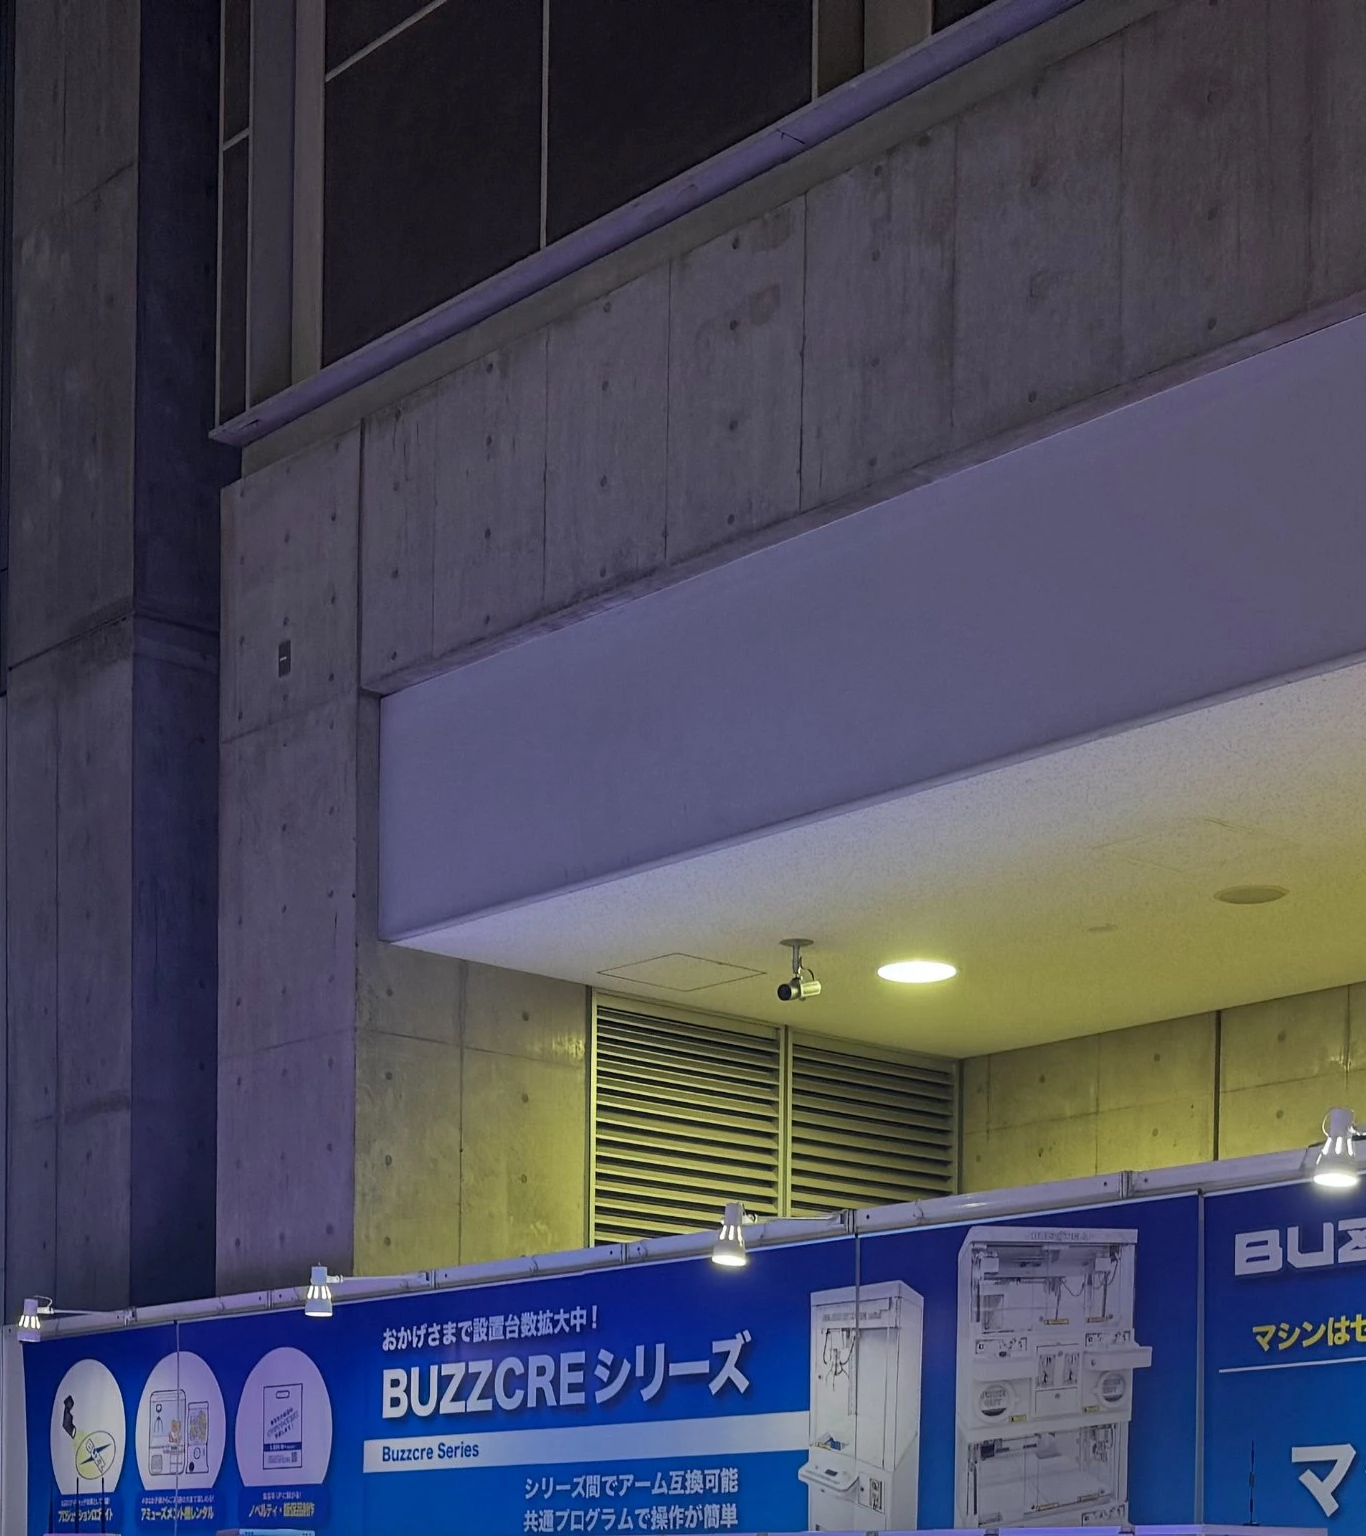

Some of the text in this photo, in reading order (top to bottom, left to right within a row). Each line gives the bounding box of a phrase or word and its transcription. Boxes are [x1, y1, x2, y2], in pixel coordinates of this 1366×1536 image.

[381, 1441, 480, 1463] Buzzcre Series
[523, 1467, 740, 1501] シリーズ間でアーム互換可能
[523, 1502, 740, 1534] 共通プログラムで操作が簡単
